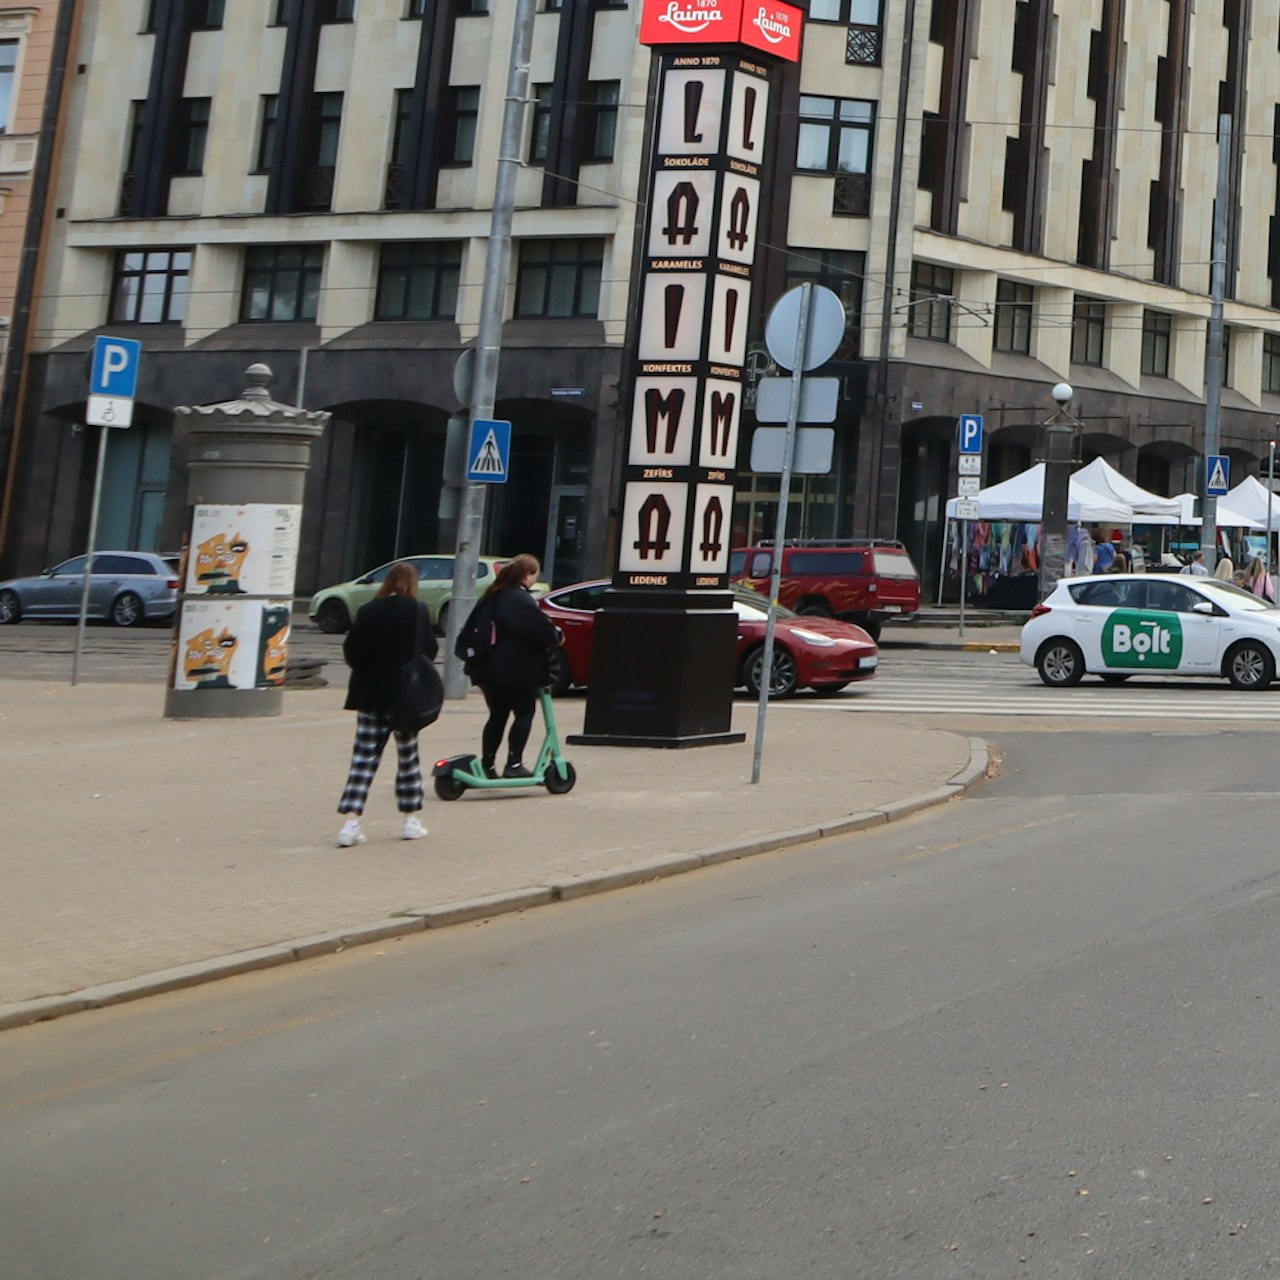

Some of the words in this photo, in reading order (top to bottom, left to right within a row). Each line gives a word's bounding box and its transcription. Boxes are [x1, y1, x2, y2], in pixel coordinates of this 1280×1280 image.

[696, 0, 717, 7] 1870
[658, 1, 723, 22] Laima
[775, 11, 789, 23] 1870
[753, 7, 791, 38] Laima
[673, 57, 700, 66] ANNO
[701, 56, 720, 65] 1870
[651, 260, 703, 269] KARAMELES
[719, 262, 750, 276] KARAMELES
[101, 344, 129, 388] P
[642, 364, 692, 373] KONFEKTES
[710, 366, 740, 377] KONFEKTES
[964, 419, 978, 449] P
[629, 576, 668, 585] LEDENES
[696, 577, 719, 586] LEDENES
[1112, 623, 1171, 660] Bolt
